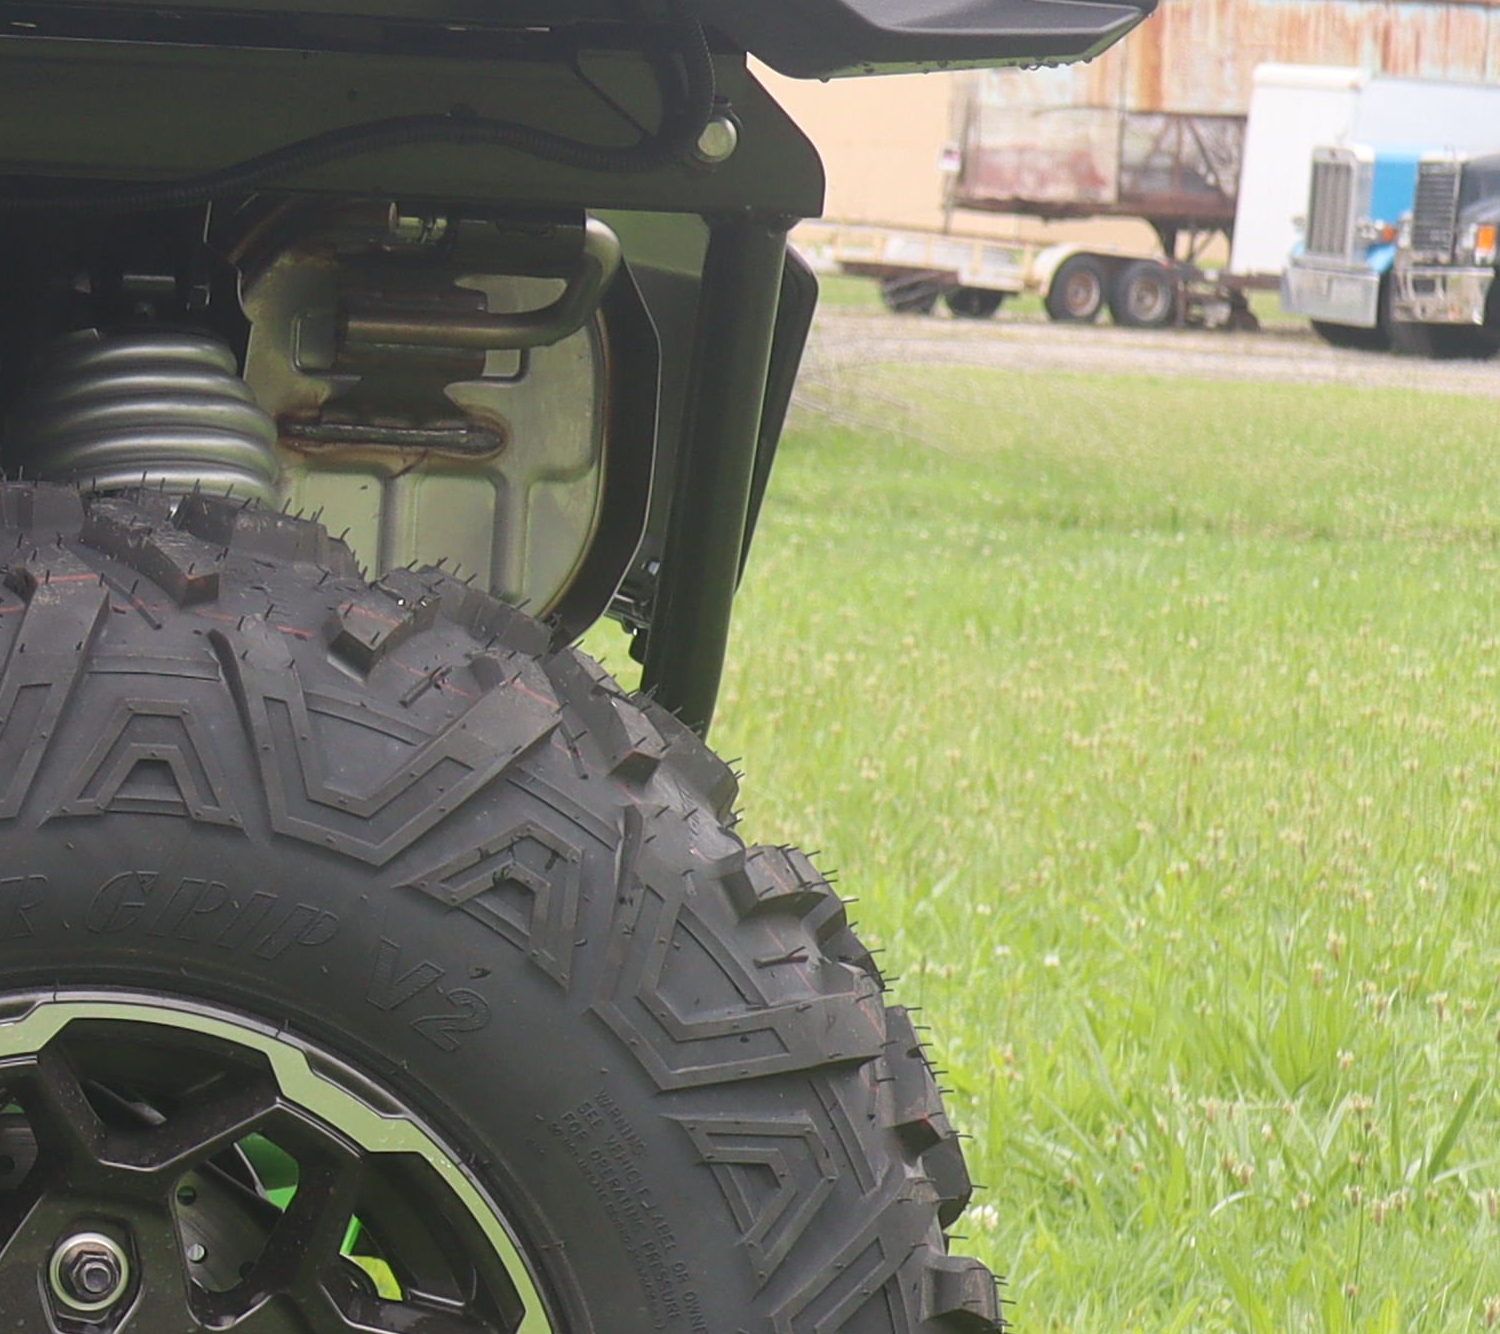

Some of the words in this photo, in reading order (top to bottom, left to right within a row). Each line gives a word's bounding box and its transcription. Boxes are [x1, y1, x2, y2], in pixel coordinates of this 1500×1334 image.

[89, 869, 340, 961] GRIP
[363, 936, 493, 1054] V2
[560, 1110, 588, 1142] FOR
[642, 1239, 682, 1323] PRESSURE
[577, 1099, 604, 1131] SEE
[605, 1132, 651, 1200] VEHICLE
[647, 1204, 678, 1253] LABEL
[671, 1260, 690, 1286] OR
